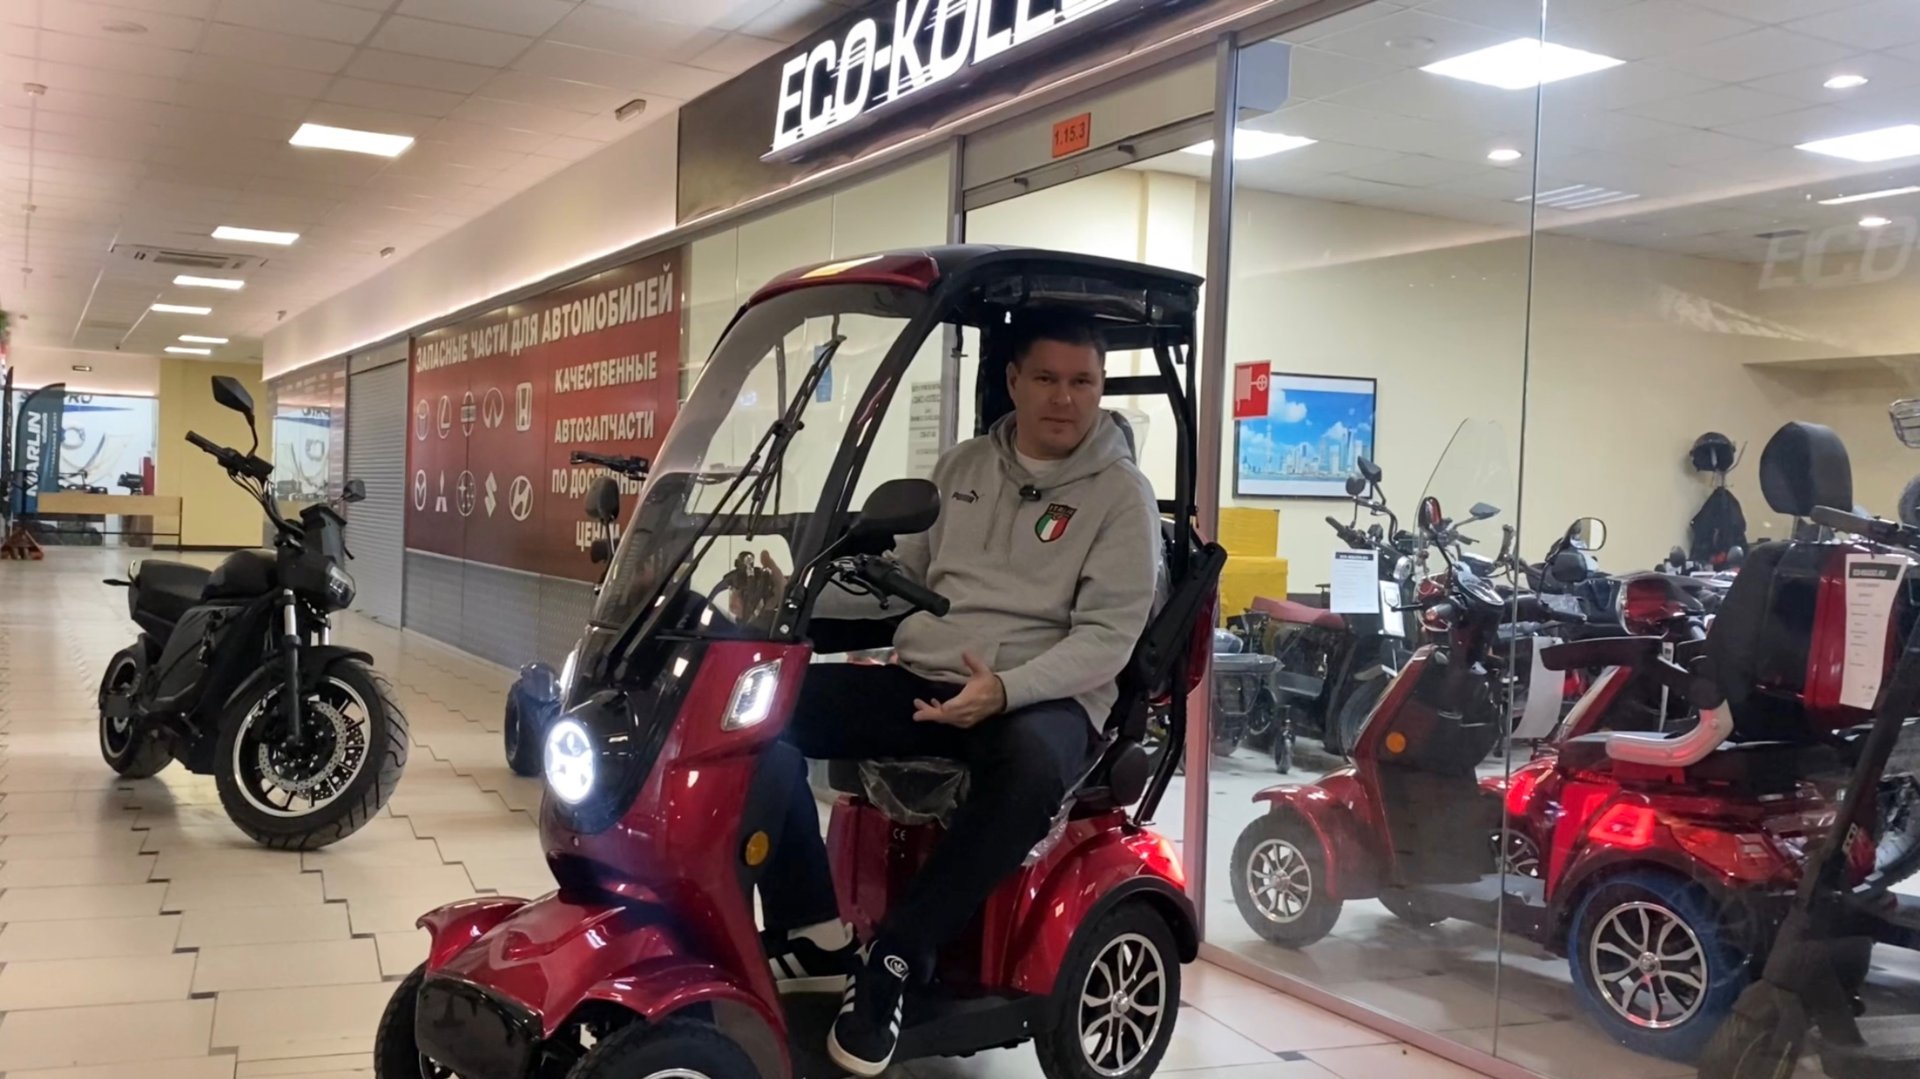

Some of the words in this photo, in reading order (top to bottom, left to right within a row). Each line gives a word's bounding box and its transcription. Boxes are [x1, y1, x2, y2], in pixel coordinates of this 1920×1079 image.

[1054, 121, 1086, 146] 1.15.3
[416, 334, 467, 372] ЗАПАСНЫЕ
[471, 323, 508, 359] ЧАСТИ
[510, 313, 538, 357] ДЛЯ
[542, 263, 673, 343] АВТОМОБИЛЕЙ
[555, 351, 658, 394] КАЧЕСТВЕННЫЕ
[554, 411, 654, 444] АВТОЗАПЧАСТИ
[552, 468, 567, 494] ПО
[892, 828, 907, 841] CE
